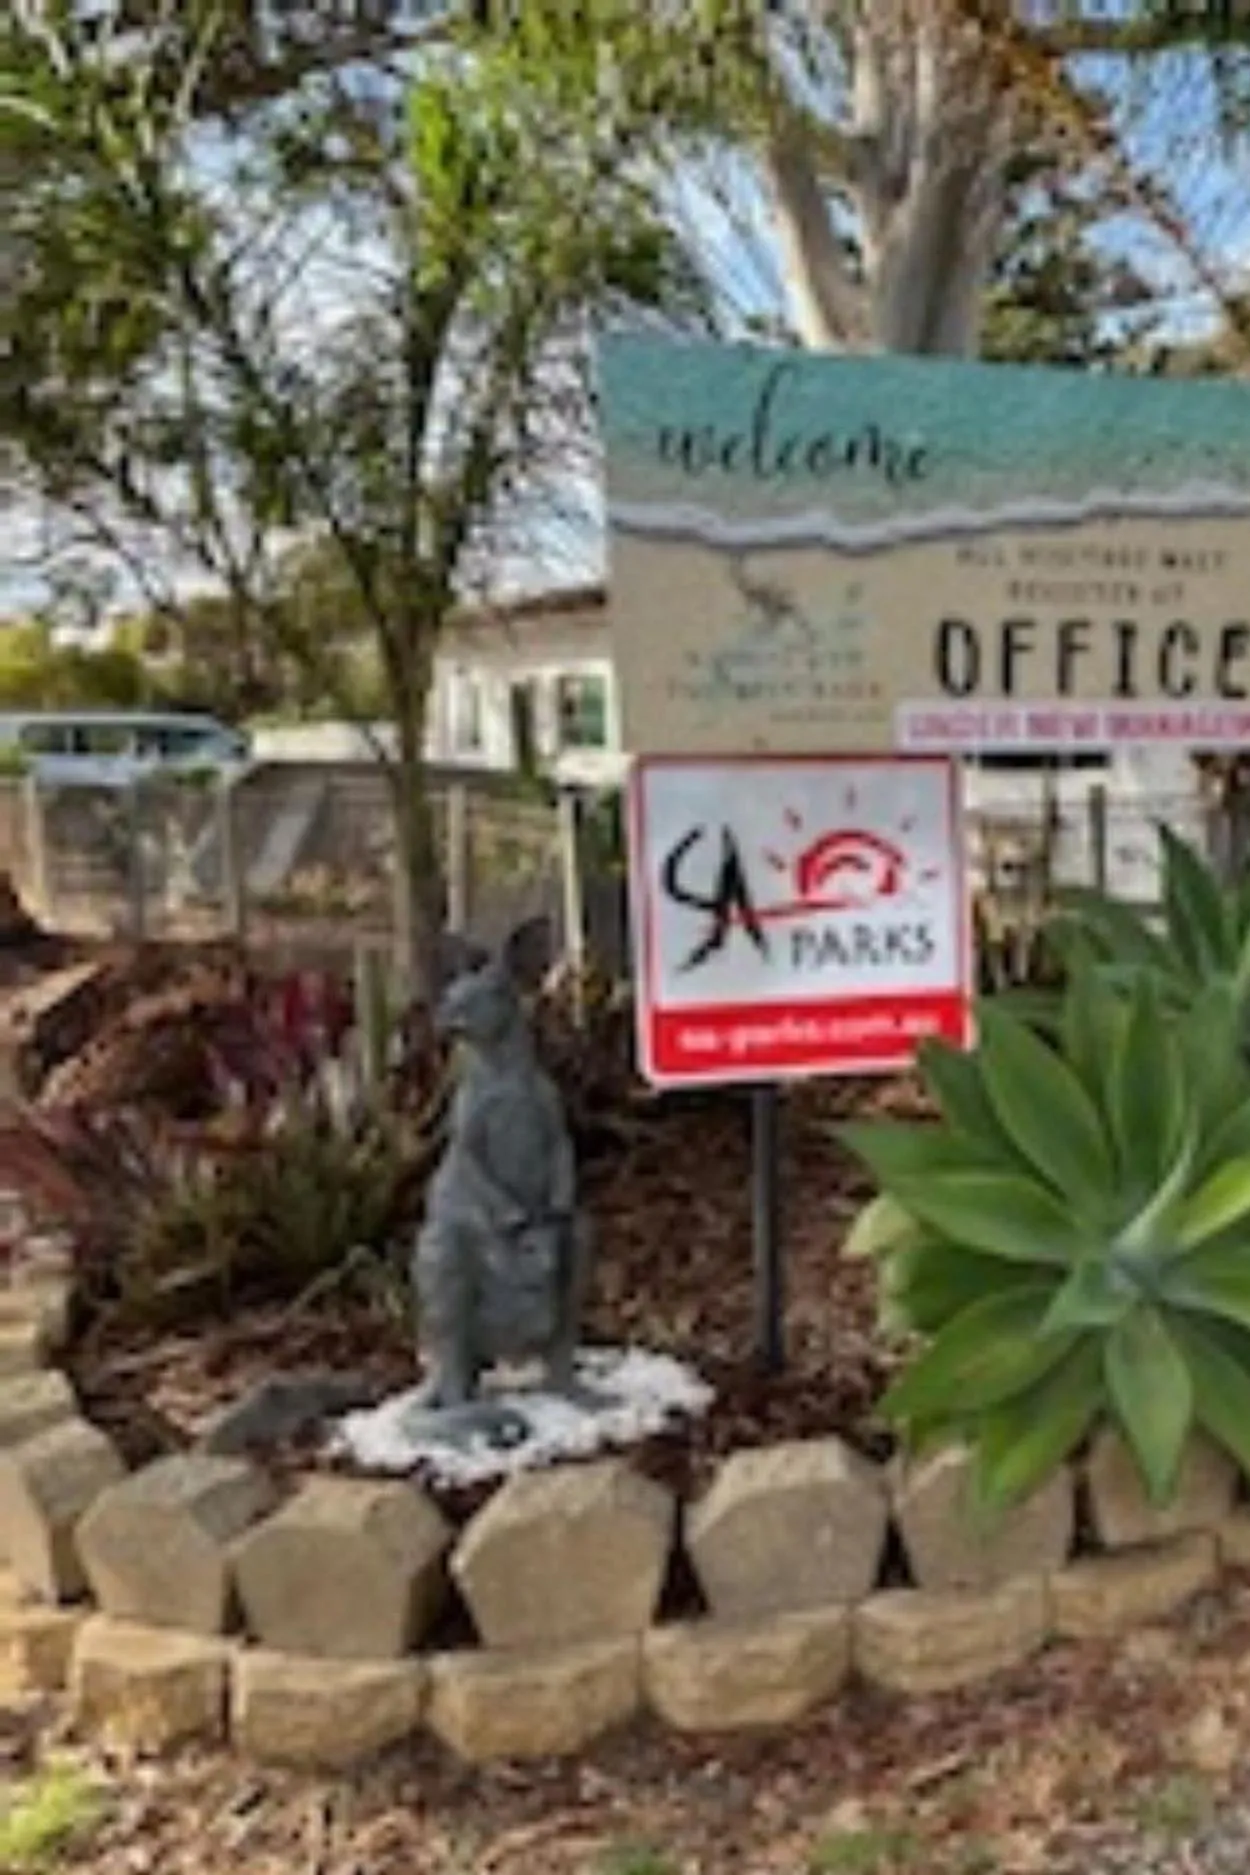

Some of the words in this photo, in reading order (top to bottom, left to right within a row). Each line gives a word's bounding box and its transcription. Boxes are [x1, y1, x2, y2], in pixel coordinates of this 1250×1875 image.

[658, 361, 927, 485] welcome
[663, 823, 770, 972] SA
[790, 924, 935, 969] PARKS
